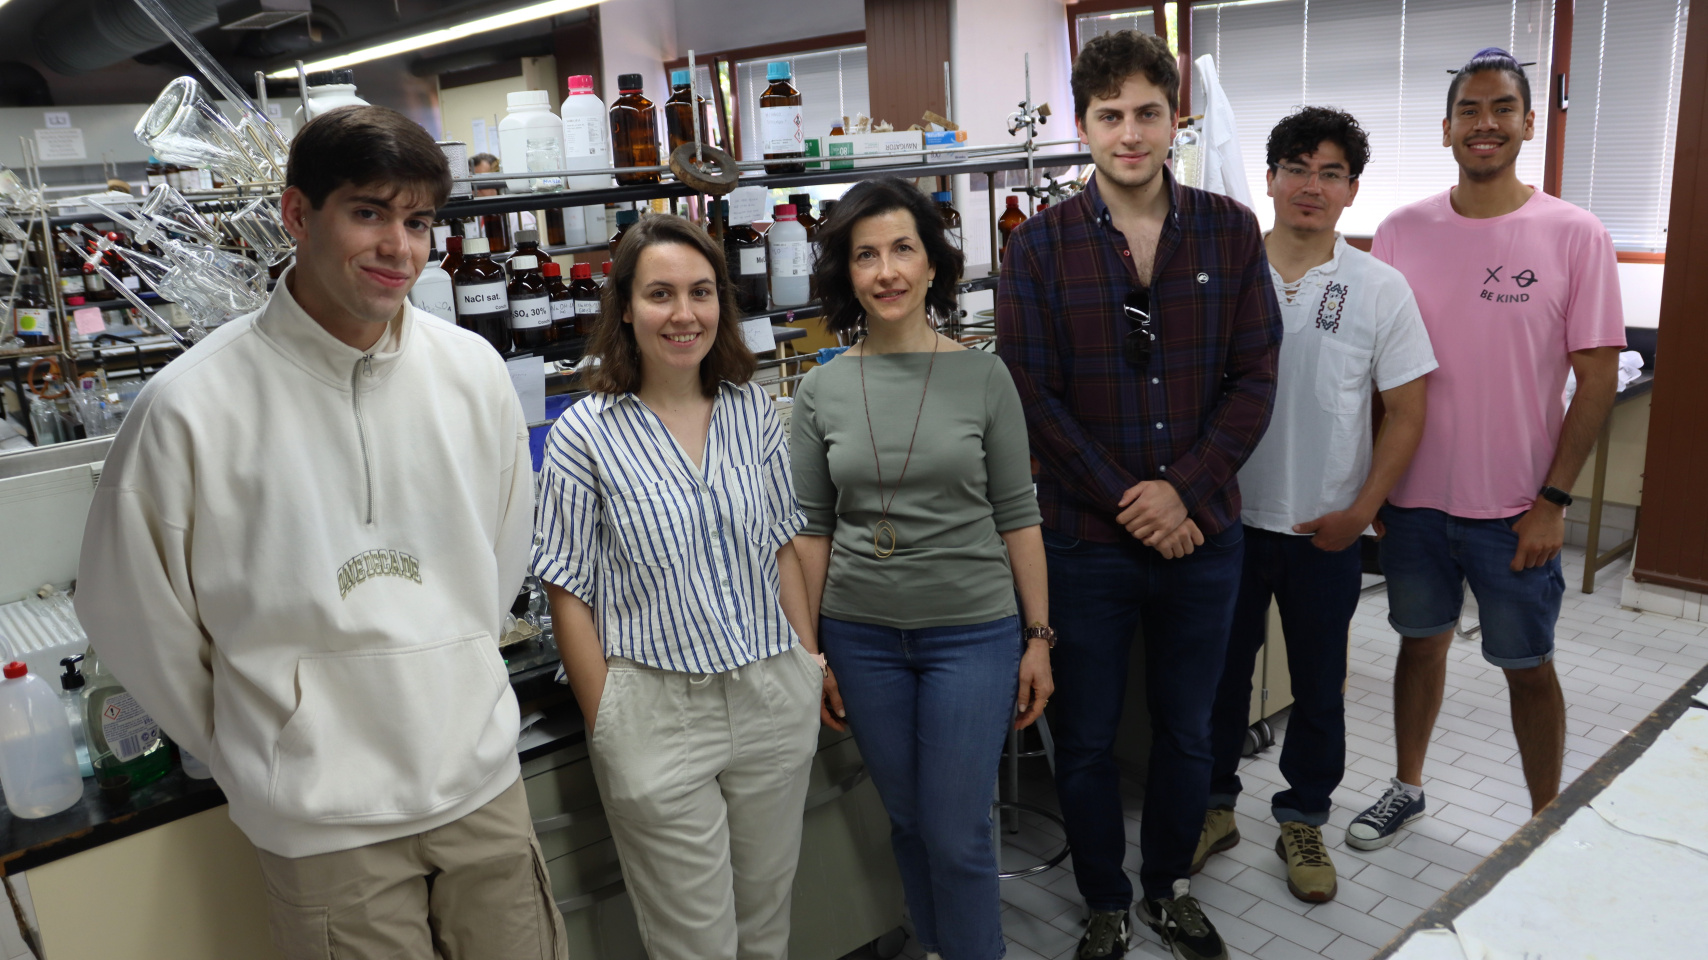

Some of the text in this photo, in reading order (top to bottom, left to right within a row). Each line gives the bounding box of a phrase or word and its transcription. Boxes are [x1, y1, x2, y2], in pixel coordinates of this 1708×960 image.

[885, 142, 918, 151] NAVIGATOR
[464, 293, 501, 303] NaCl sat.
[1479, 289, 1530, 303] BE KIND
[530, 307, 547, 316] 30%
[337, 549, 422, 600] ONE DECADE
